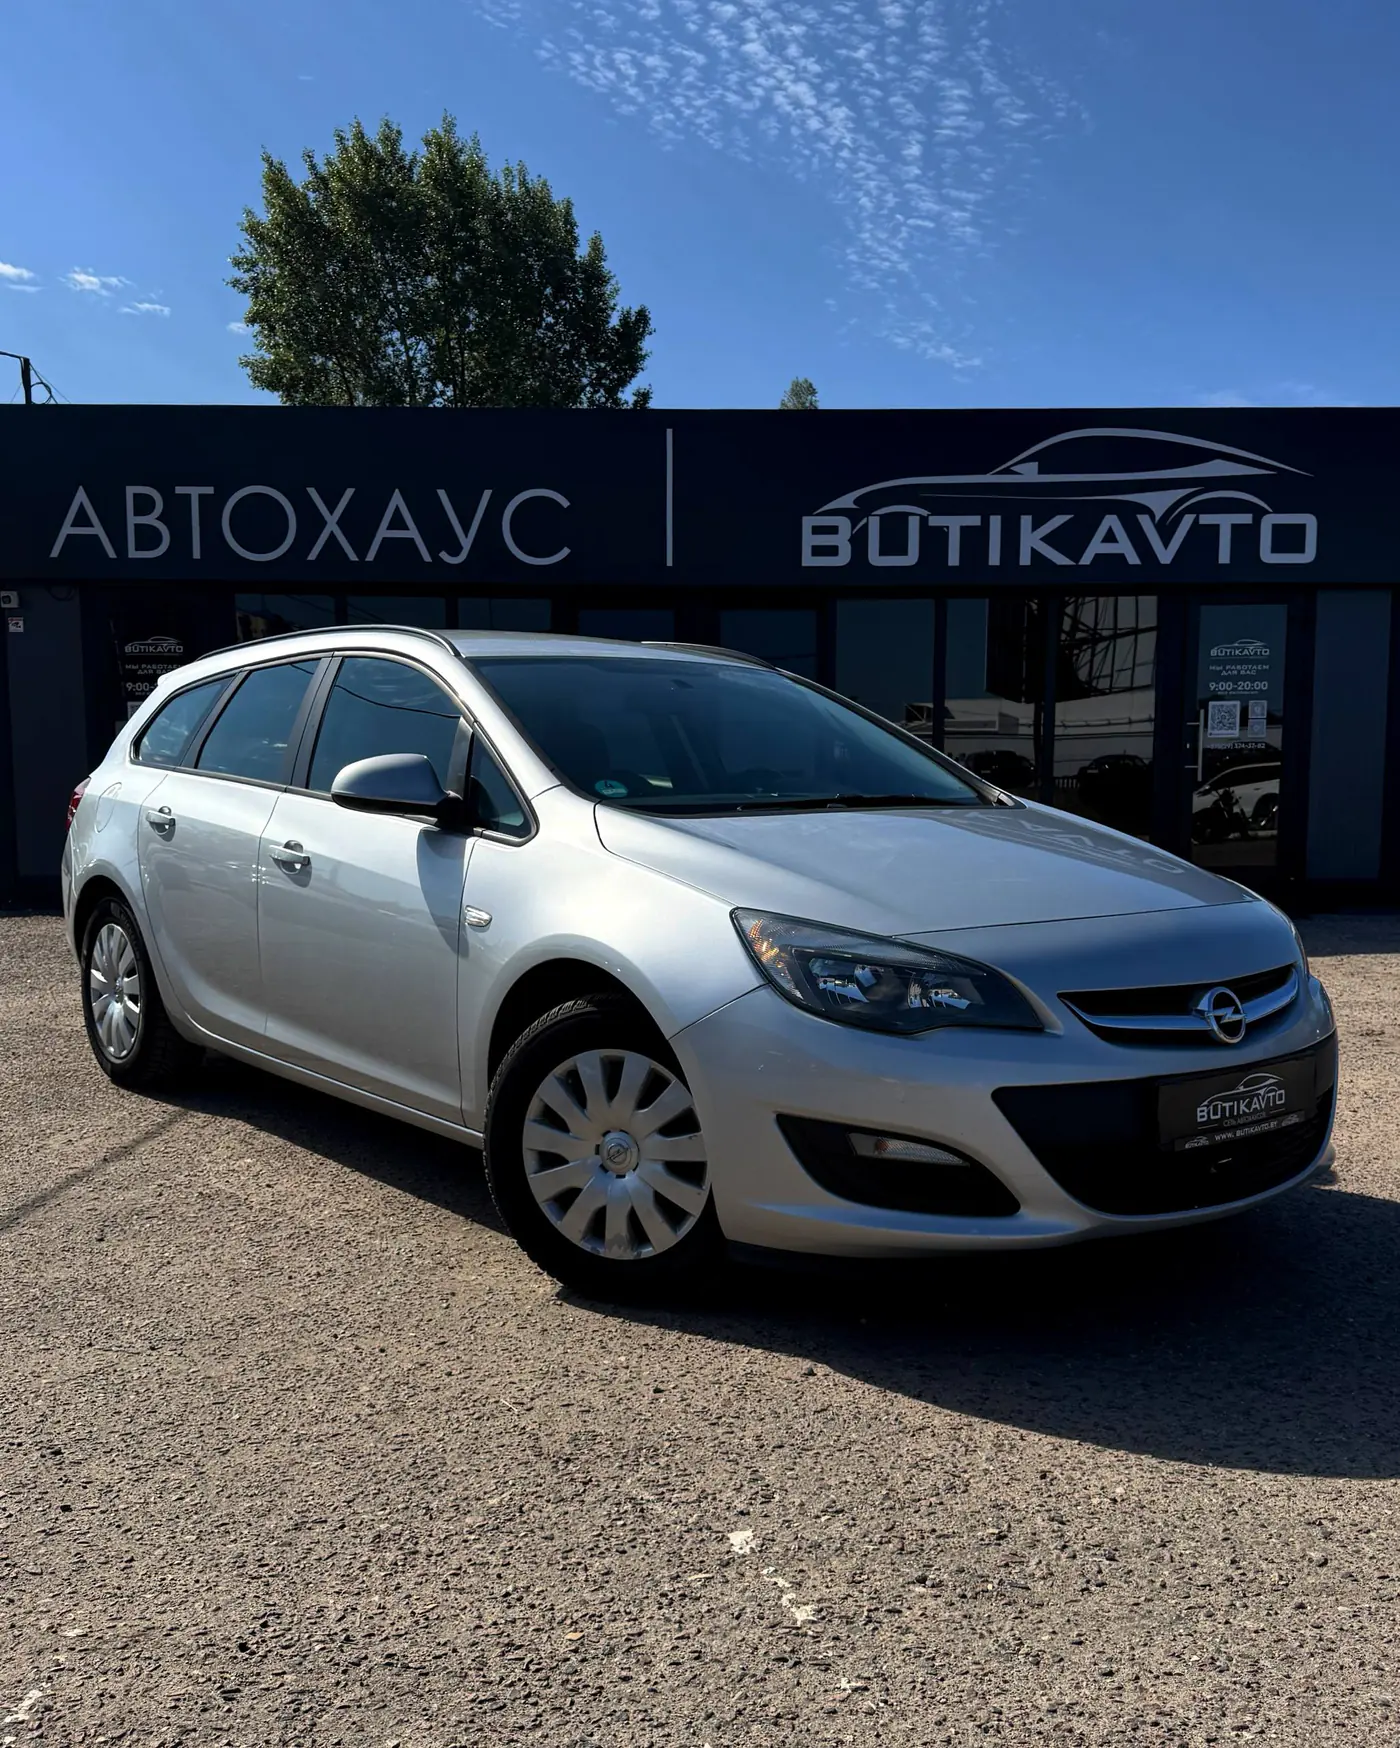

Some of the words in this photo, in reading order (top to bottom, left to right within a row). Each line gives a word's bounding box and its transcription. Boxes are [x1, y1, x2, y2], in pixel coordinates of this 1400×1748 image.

[50, 485, 572, 566] АВТОХАУС
[801, 513, 1318, 567] BUTIKAVTO
[124, 645, 183, 653] BUTIKAVTO
[1210, 648, 1270, 656] BUTIKAVTO
[126, 682, 158, 692] 9:00-
[1209, 681, 1269, 691] 9:00-20:00
[1197, 1090, 1285, 1122] BUTIKAVTO
